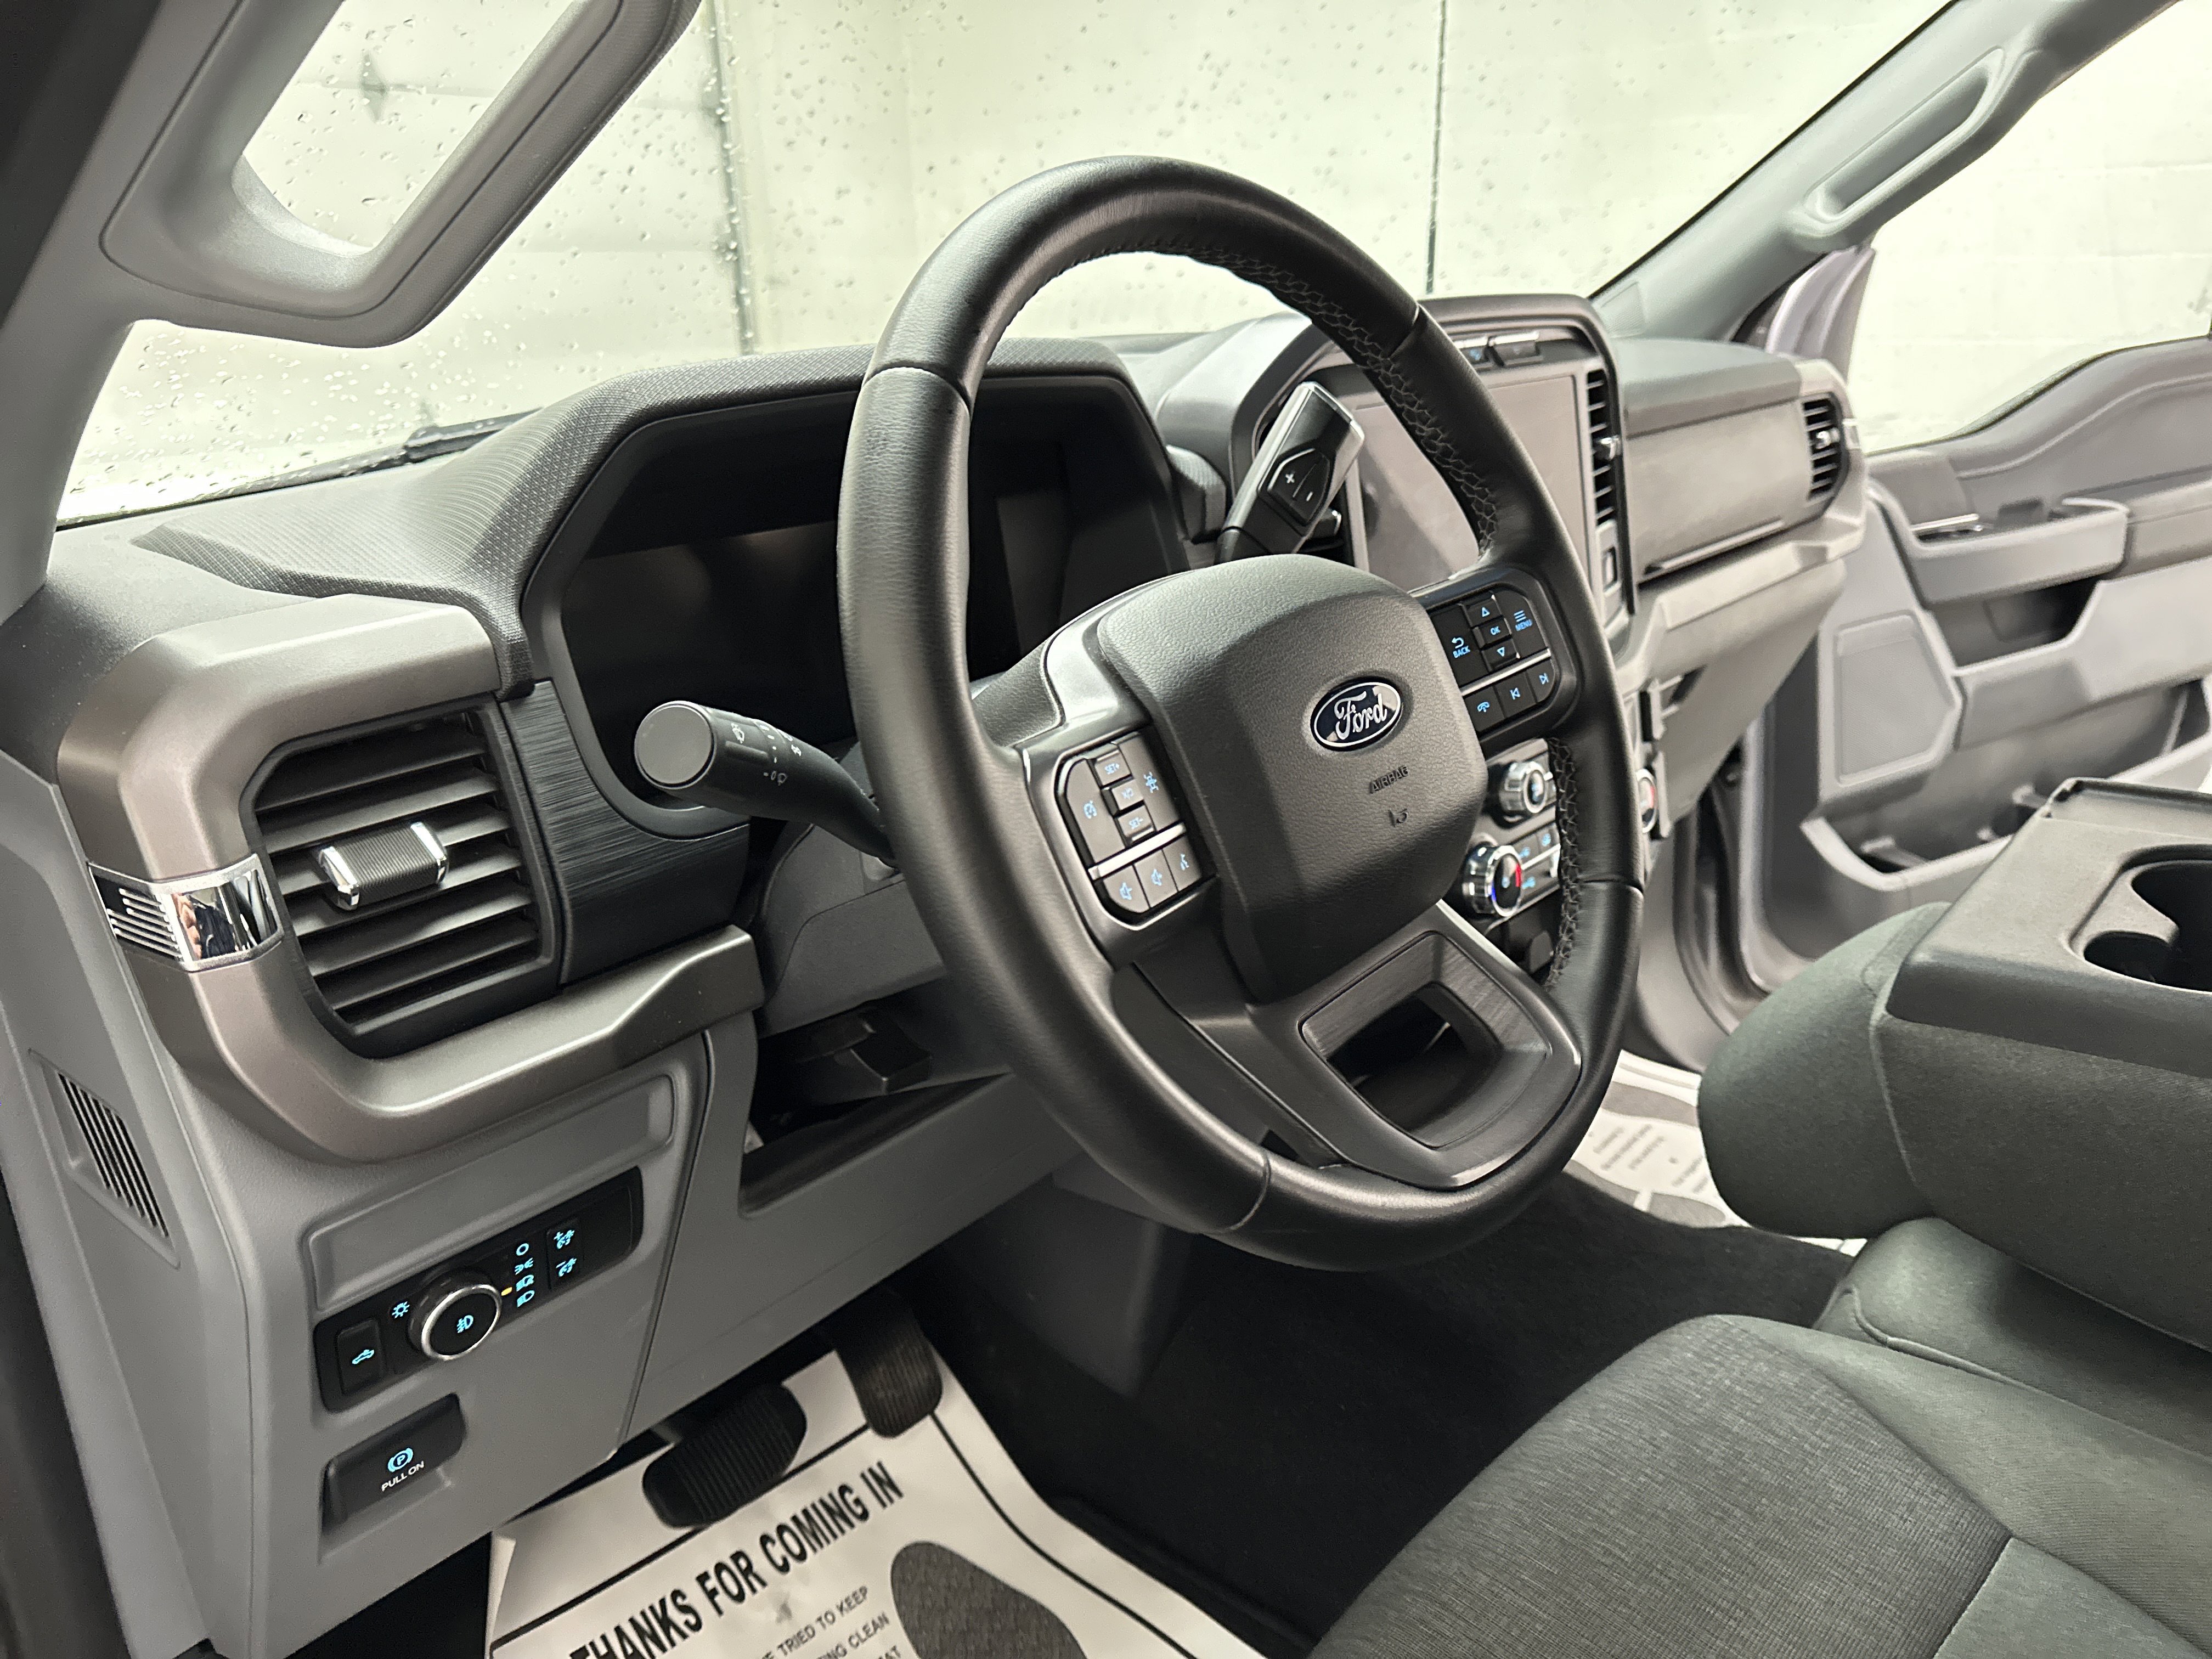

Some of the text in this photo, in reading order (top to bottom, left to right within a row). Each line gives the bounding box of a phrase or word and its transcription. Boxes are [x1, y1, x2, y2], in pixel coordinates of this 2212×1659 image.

[1490, 626, 1501, 635] OK
[1515, 619, 1532, 631] MENU
[1453, 645, 1471, 658] BACK
[1334, 691, 1387, 740] Ford
[1369, 766, 1409, 794] AIRBAG
[381, 1460, 425, 1492] PULL ON
[695, 1550, 768, 1617] FOR
[759, 1483, 870, 1576] COMING
[860, 1461, 904, 1510] IN
[777, 1624, 816, 1656] TRIED
[816, 1610, 836, 1630] TO
[836, 1585, 868, 1617] KEEP
[848, 1611, 890, 1649] CLEAN
